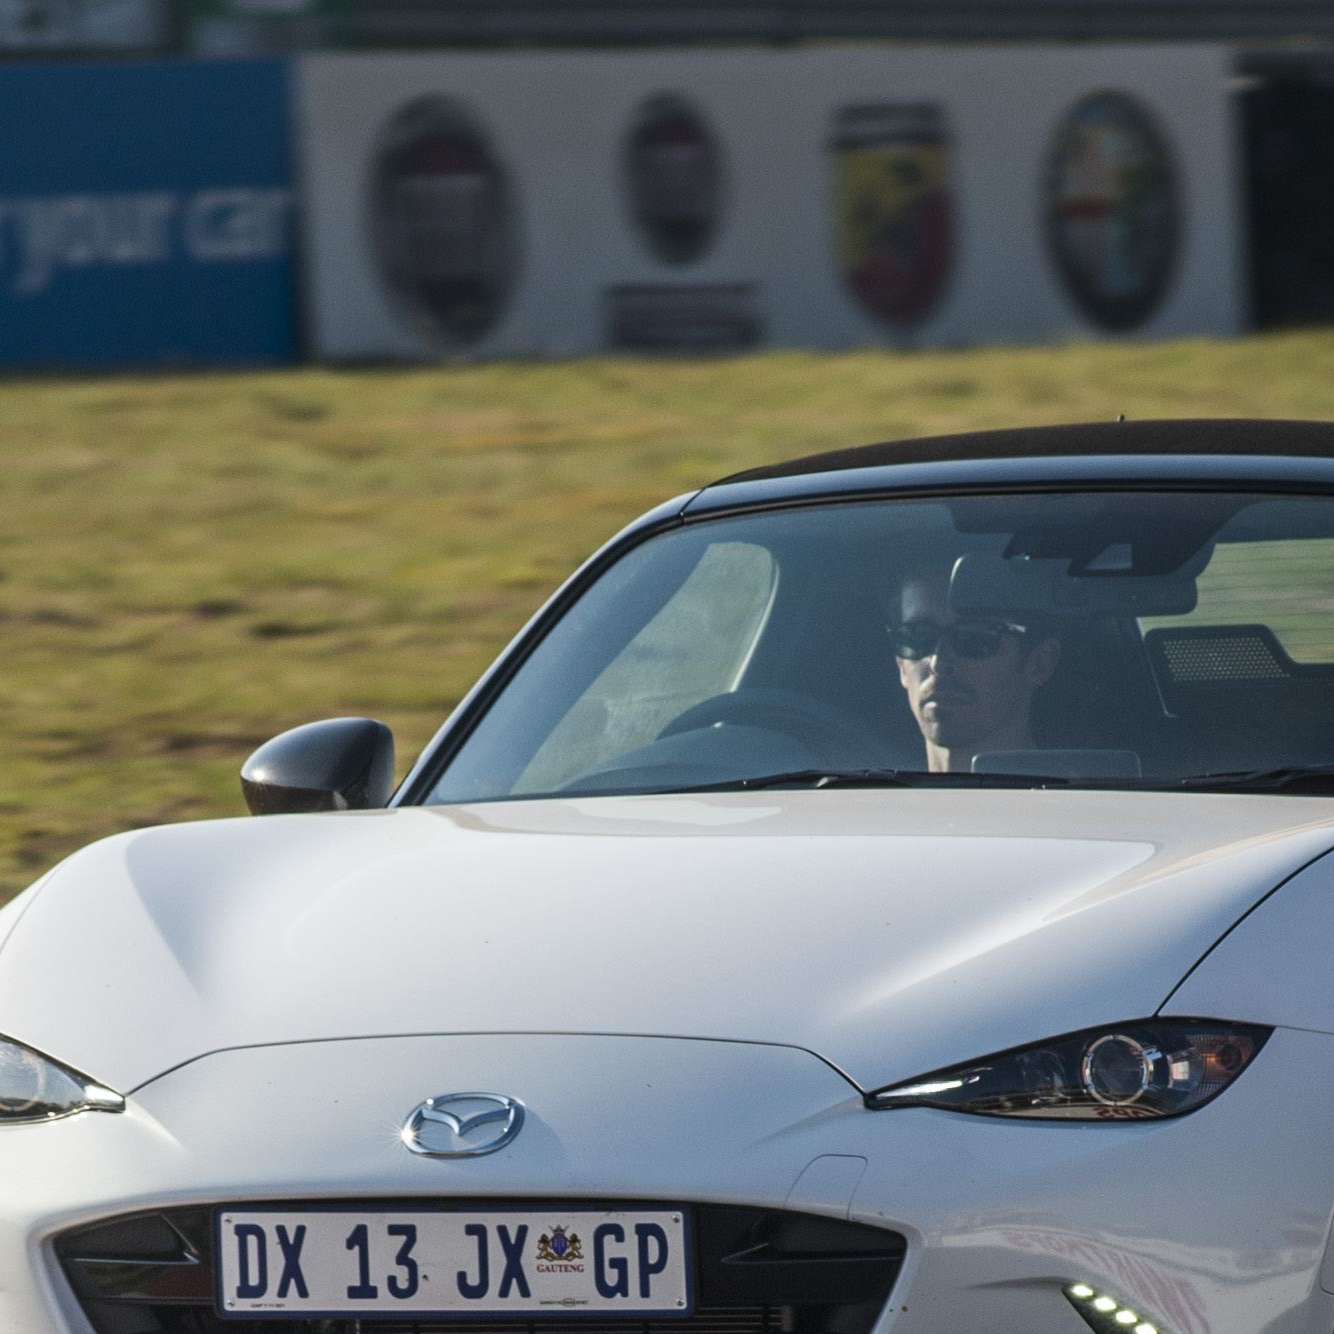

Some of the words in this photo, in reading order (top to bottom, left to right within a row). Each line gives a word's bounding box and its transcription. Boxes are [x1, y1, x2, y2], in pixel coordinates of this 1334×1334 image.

[12, 192, 173, 294] your
[234, 1223, 309, 1299] DX
[346, 1223, 419, 1299] 13
[456, 1223, 531, 1299] JX
[593, 1222, 669, 1299] GP
[536, 1264, 585, 1273] GAUTENG
